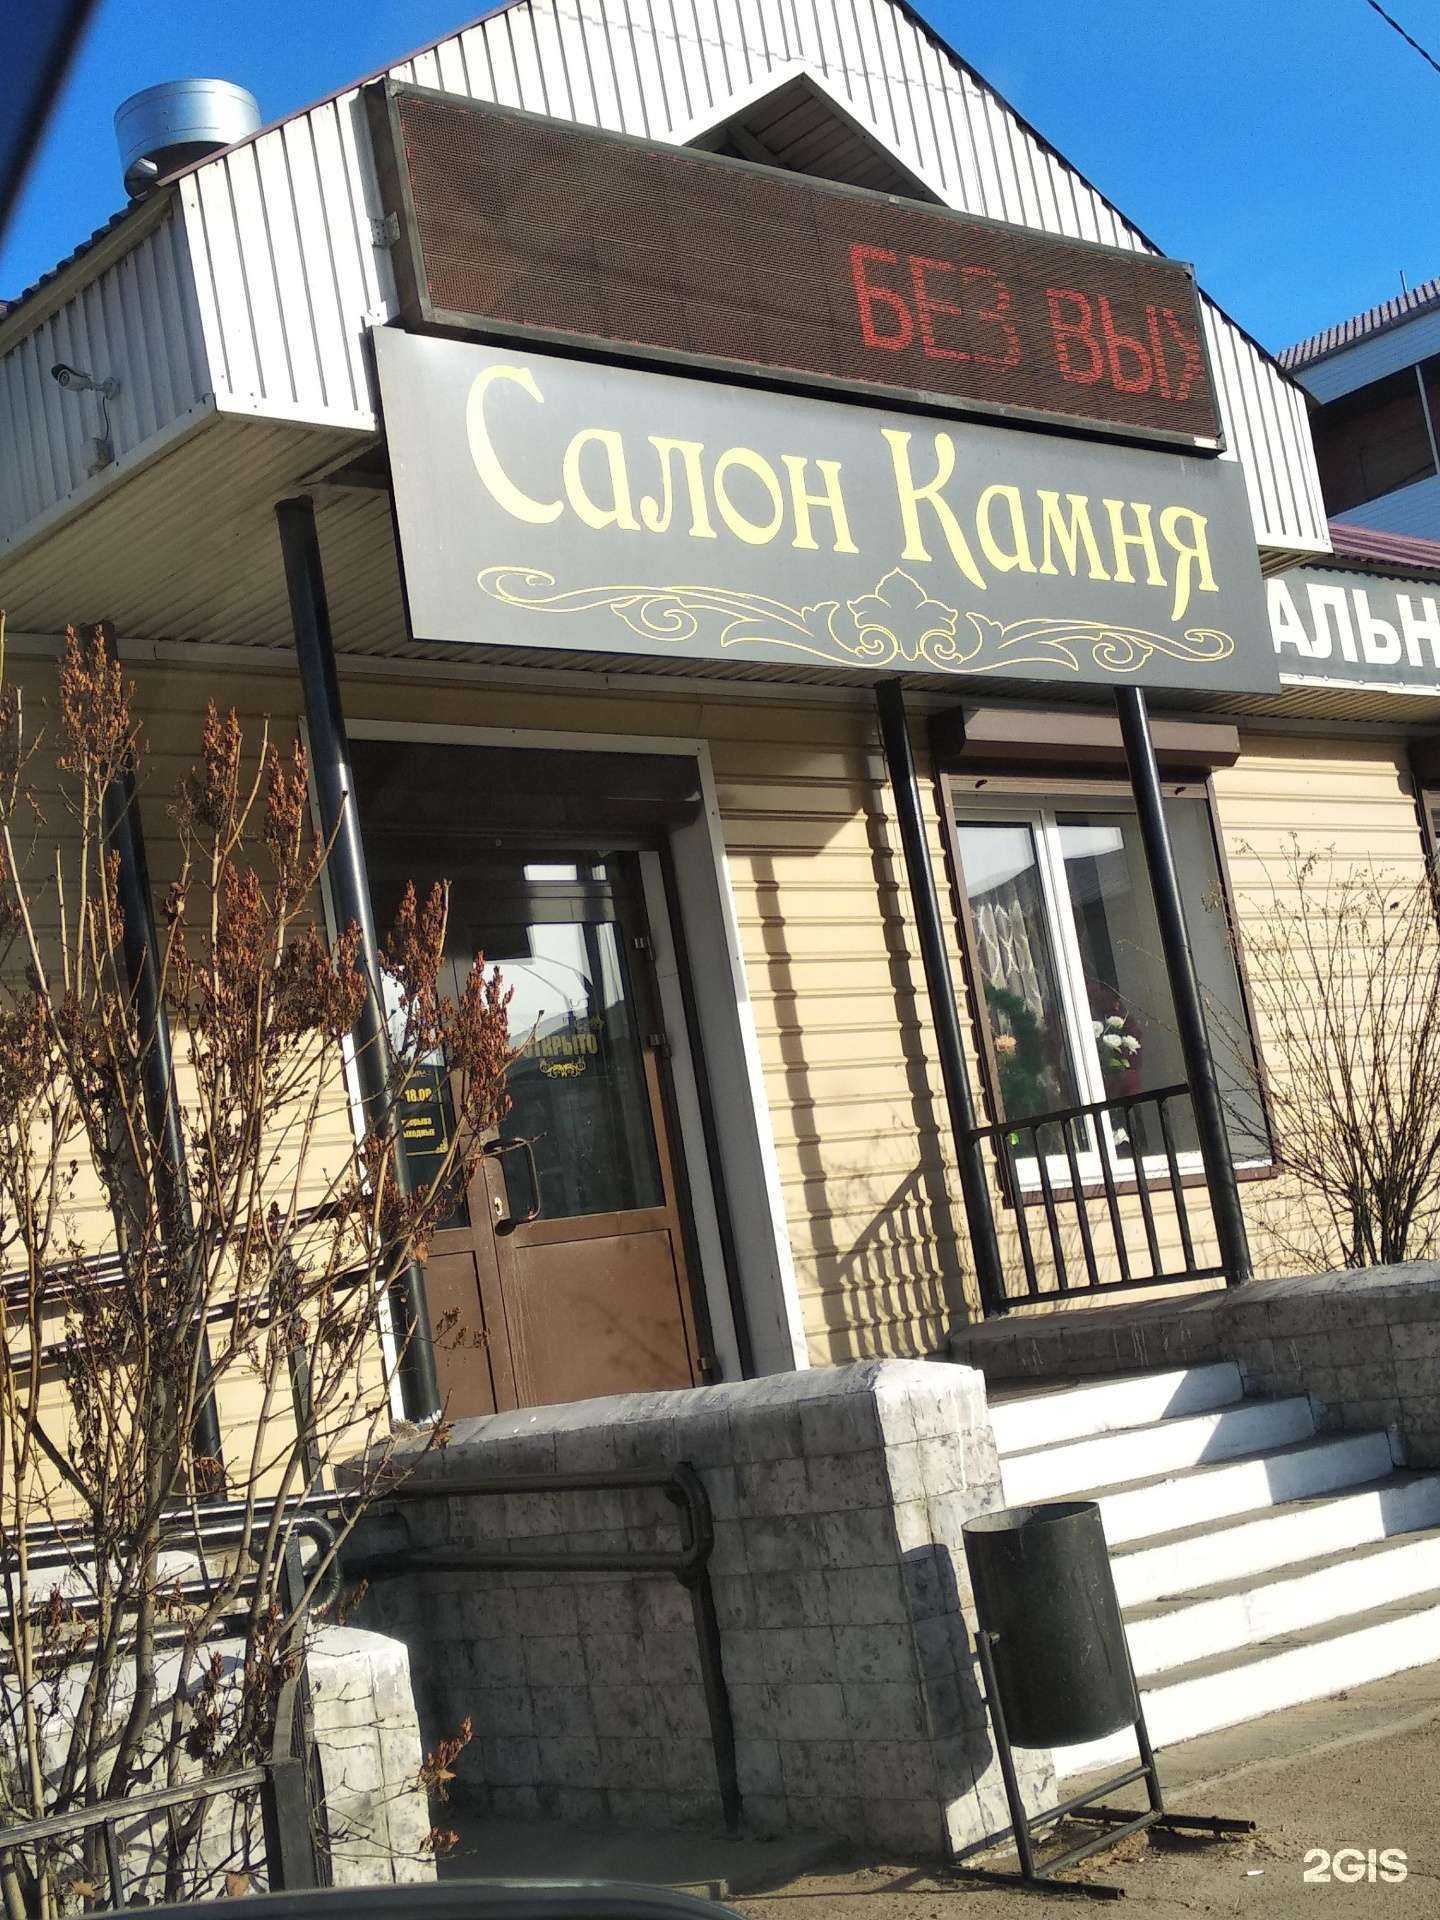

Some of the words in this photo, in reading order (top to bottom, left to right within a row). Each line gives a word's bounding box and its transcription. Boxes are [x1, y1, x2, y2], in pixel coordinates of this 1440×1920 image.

[849, 243, 1021, 369] БЕЗ
[466, 364, 860, 554] Салон
[880, 428, 1220, 622] Камня
